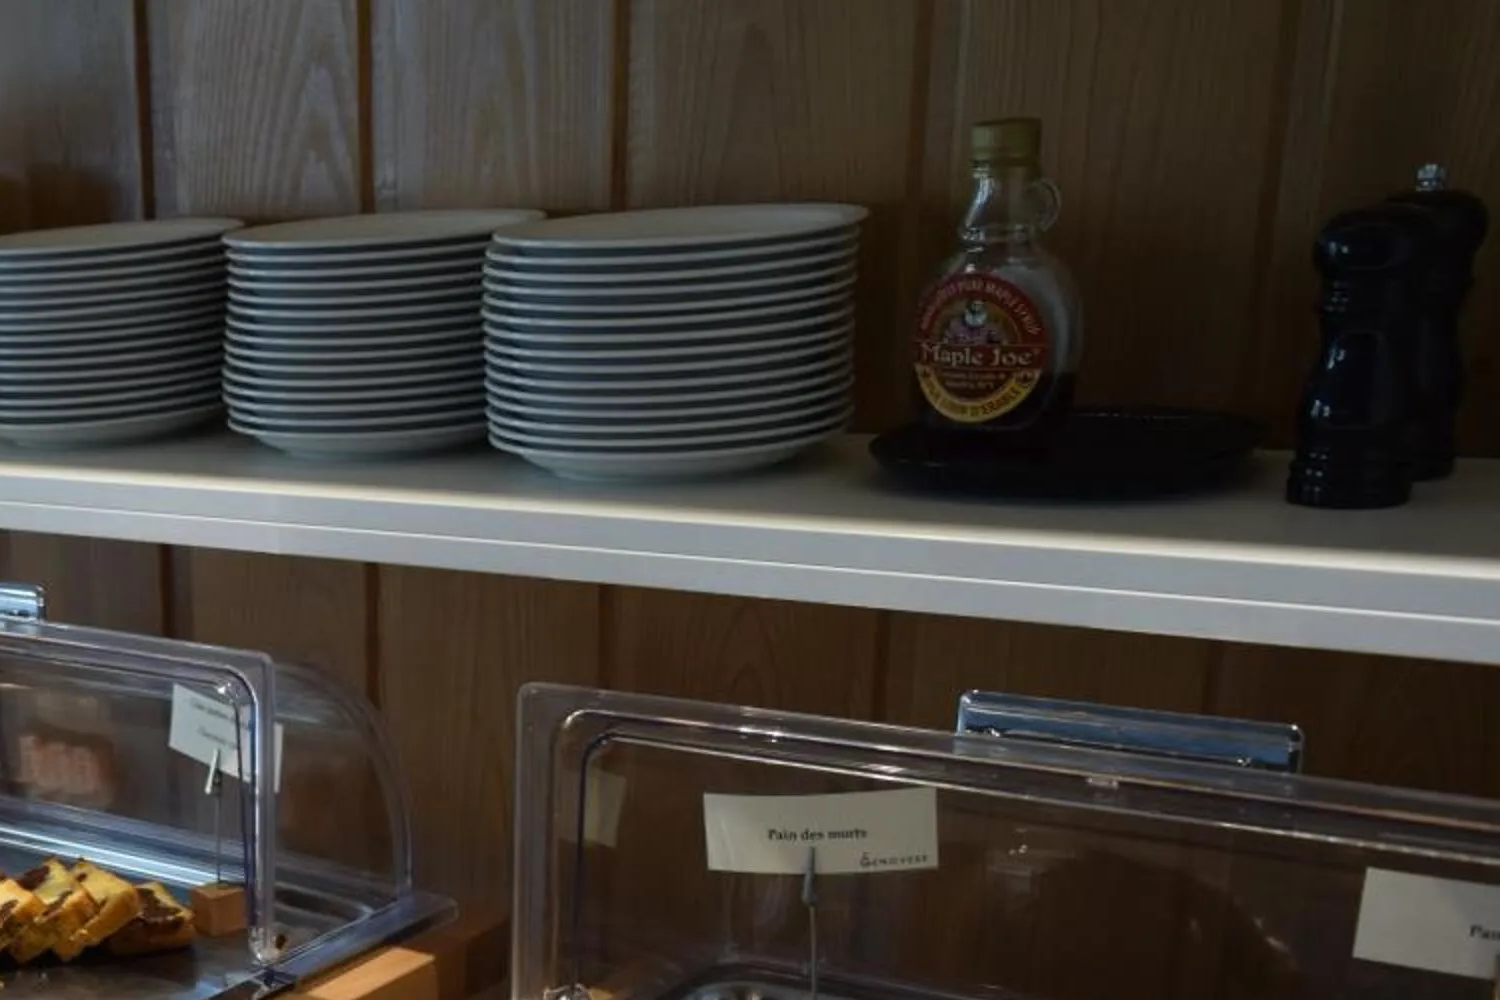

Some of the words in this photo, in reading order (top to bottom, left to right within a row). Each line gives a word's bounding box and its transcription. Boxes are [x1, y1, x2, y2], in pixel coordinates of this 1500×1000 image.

[920, 341, 984, 367] Maple
[990, 346, 1033, 366] Joe
[768, 828, 797, 841] Pain
[800, 827, 824, 841] des
